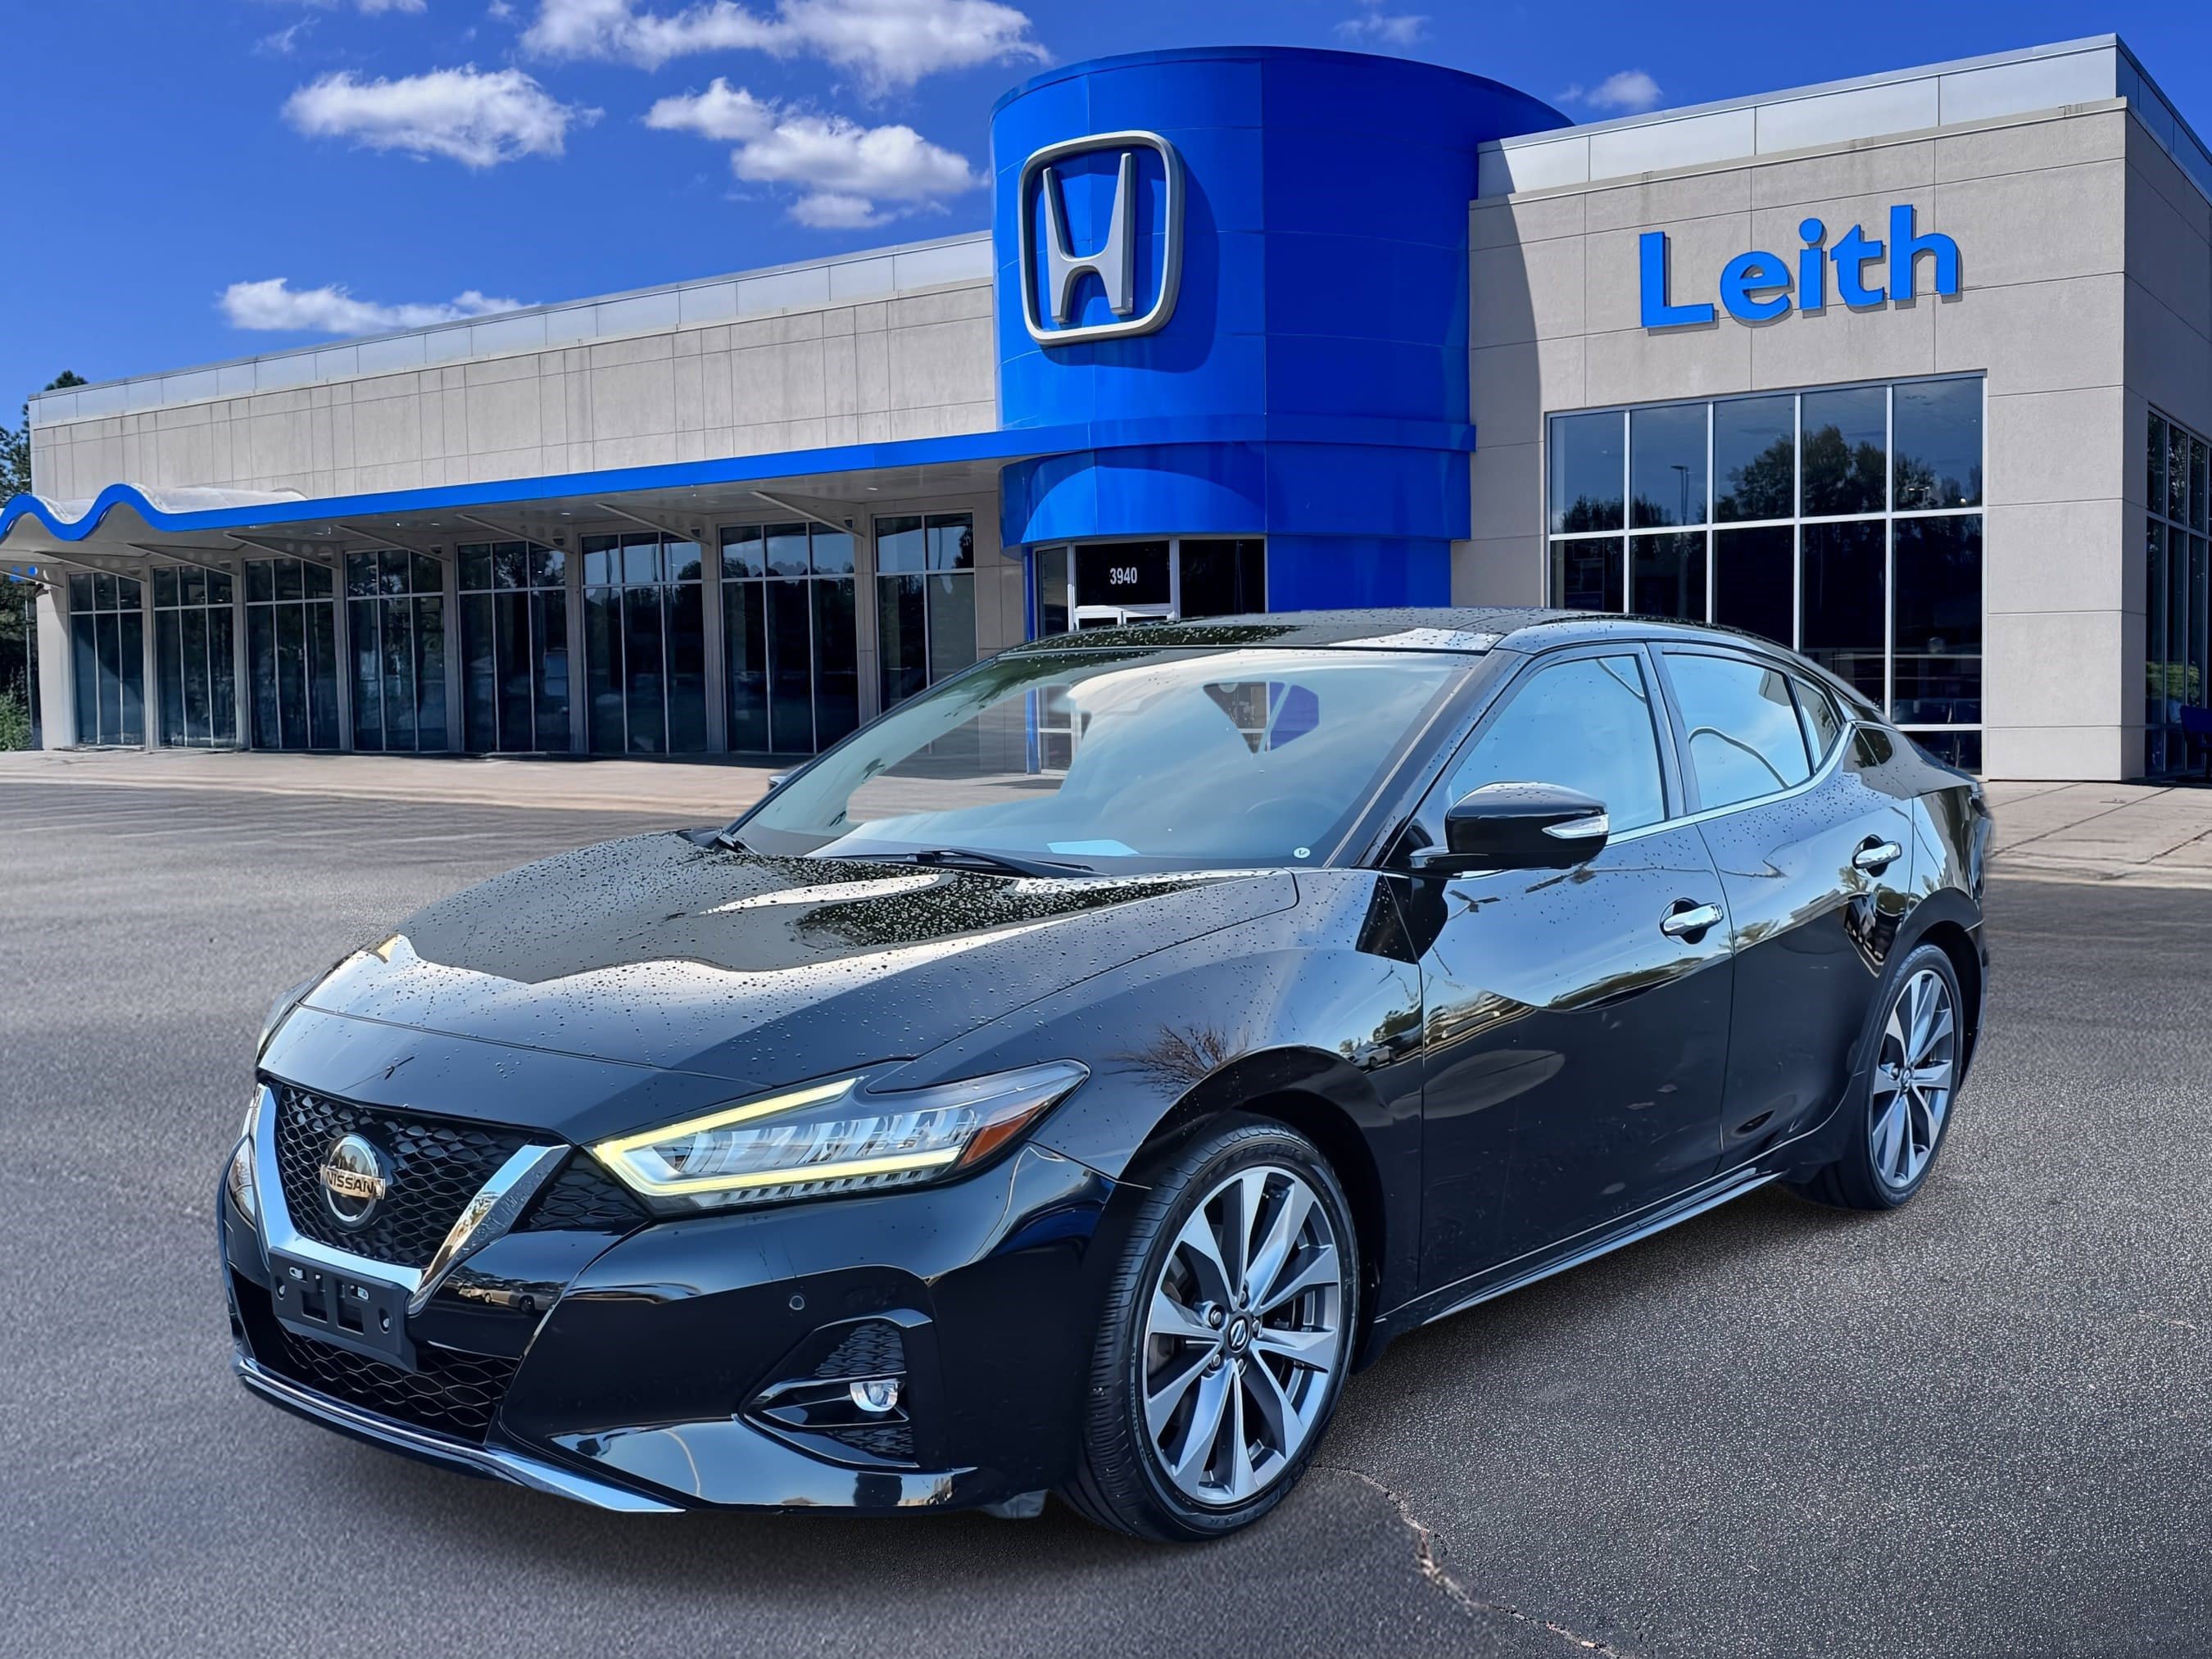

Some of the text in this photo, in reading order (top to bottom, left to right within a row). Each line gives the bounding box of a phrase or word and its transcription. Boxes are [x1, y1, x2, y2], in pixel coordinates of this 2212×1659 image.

[1639, 204, 1959, 329] Leith
[1109, 566, 1138, 585] 3940
[327, 1170, 374, 1194] NISSAN
